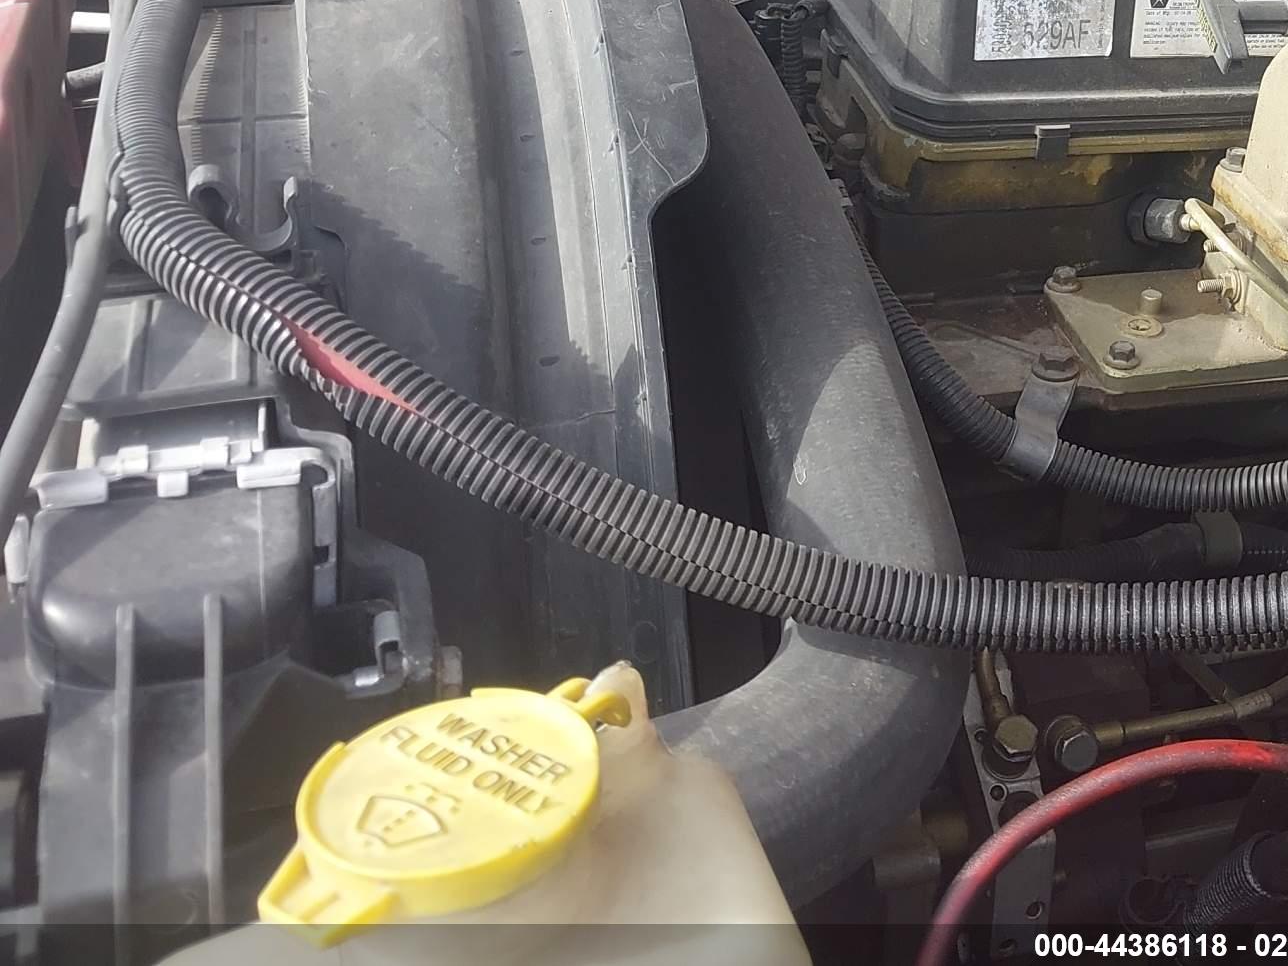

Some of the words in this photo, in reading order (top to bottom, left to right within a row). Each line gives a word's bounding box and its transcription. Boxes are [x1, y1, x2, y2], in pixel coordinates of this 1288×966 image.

[380, 726, 478, 777] FLUID
[472, 769, 564, 816] ONLY
[436, 713, 573, 786] WASHER
